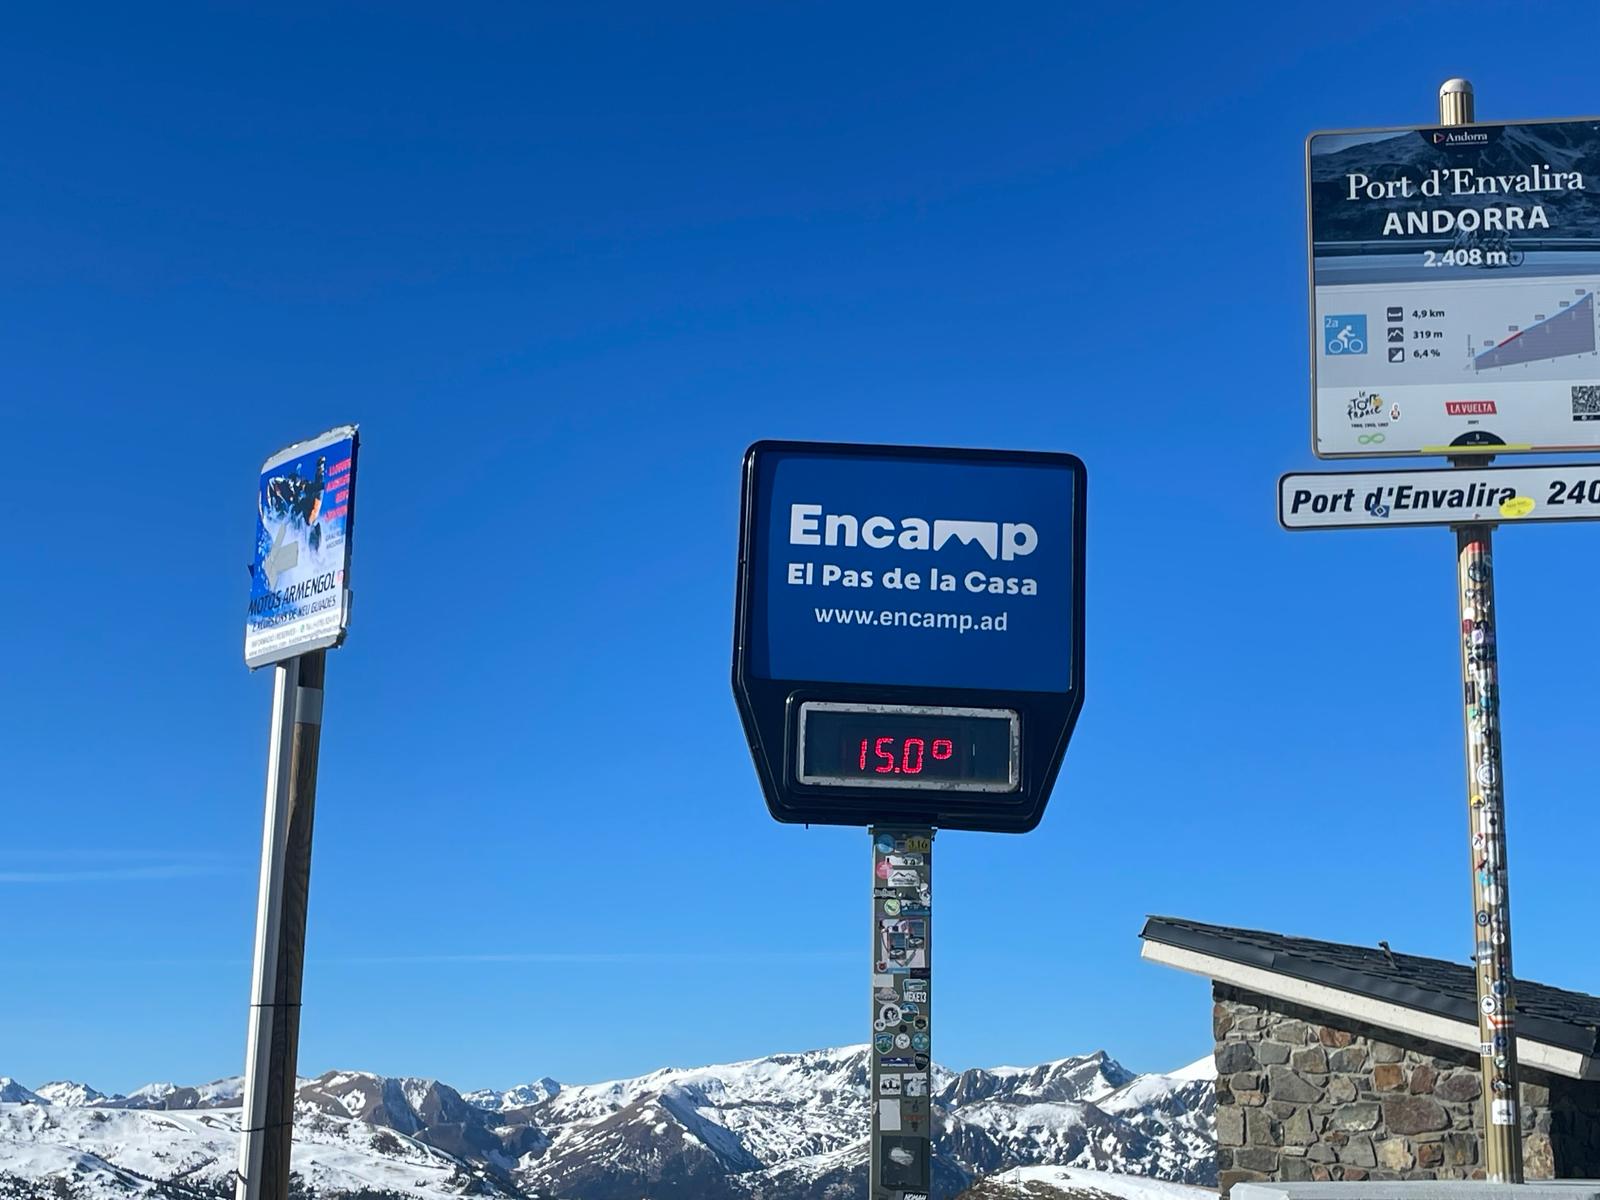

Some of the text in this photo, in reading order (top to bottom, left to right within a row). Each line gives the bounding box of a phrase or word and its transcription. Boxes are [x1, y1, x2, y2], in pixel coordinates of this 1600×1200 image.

[1446, 131, 1488, 142] Andorra
[1346, 163, 1586, 201] Port d'Envalira
[1382, 205, 1550, 236] ANDORRA
[1423, 249, 1507, 268] 2.408 m
[1325, 318, 1339, 329] 2a
[1412, 309, 1445, 320] 4,9 km
[1412, 330, 1443, 340] 319 m
[1413, 348, 1441, 360] 6,4 %
[1450, 402, 1493, 414] LA VUELTA
[1291, 488, 1355, 514] Port
[1364, 482, 1517, 511] d'Envalira
[789, 503, 1038, 561] Encamp
[787, 562, 1038, 596] El Pas de la Casa
[247, 570, 336, 616] MOTOS ARMENGOL
[814, 607, 1008, 634] www.encamp.ad
